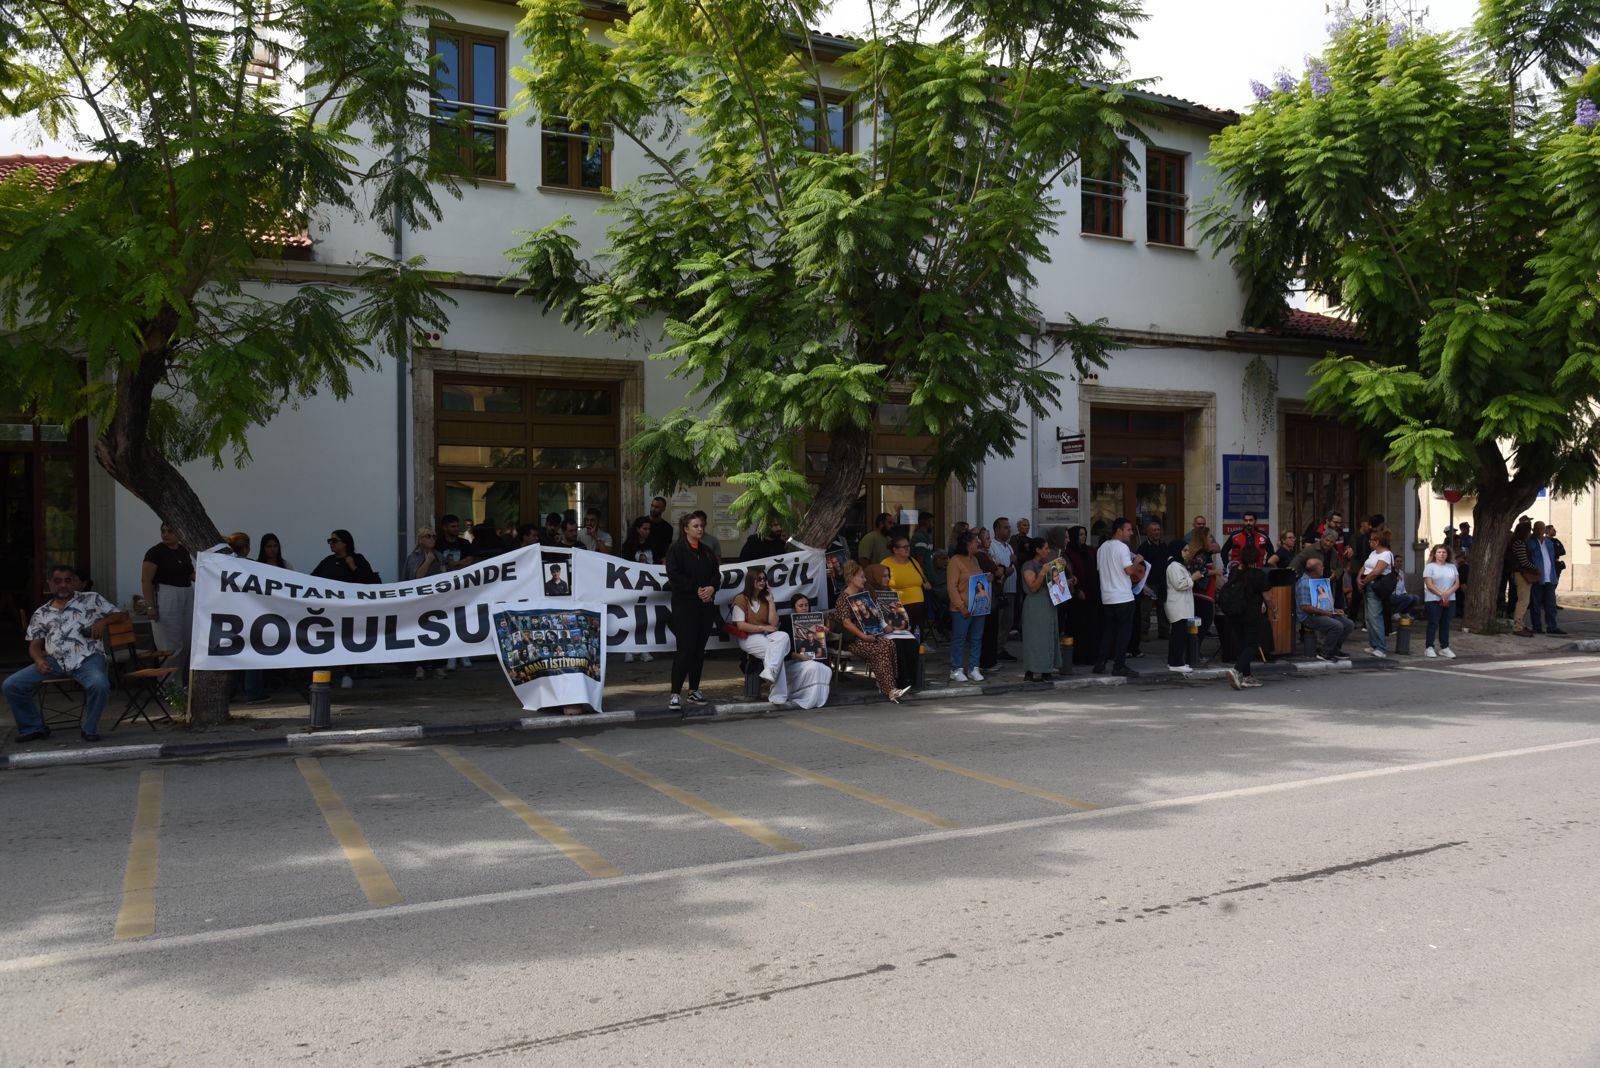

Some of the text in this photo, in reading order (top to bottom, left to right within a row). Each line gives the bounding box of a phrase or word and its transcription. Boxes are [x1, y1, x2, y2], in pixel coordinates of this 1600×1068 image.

[220, 561, 517, 600] KAPTAN NEFESİNDE
[720, 557, 814, 589] DĞİL
[207, 600, 528, 656] BOĞULSU
